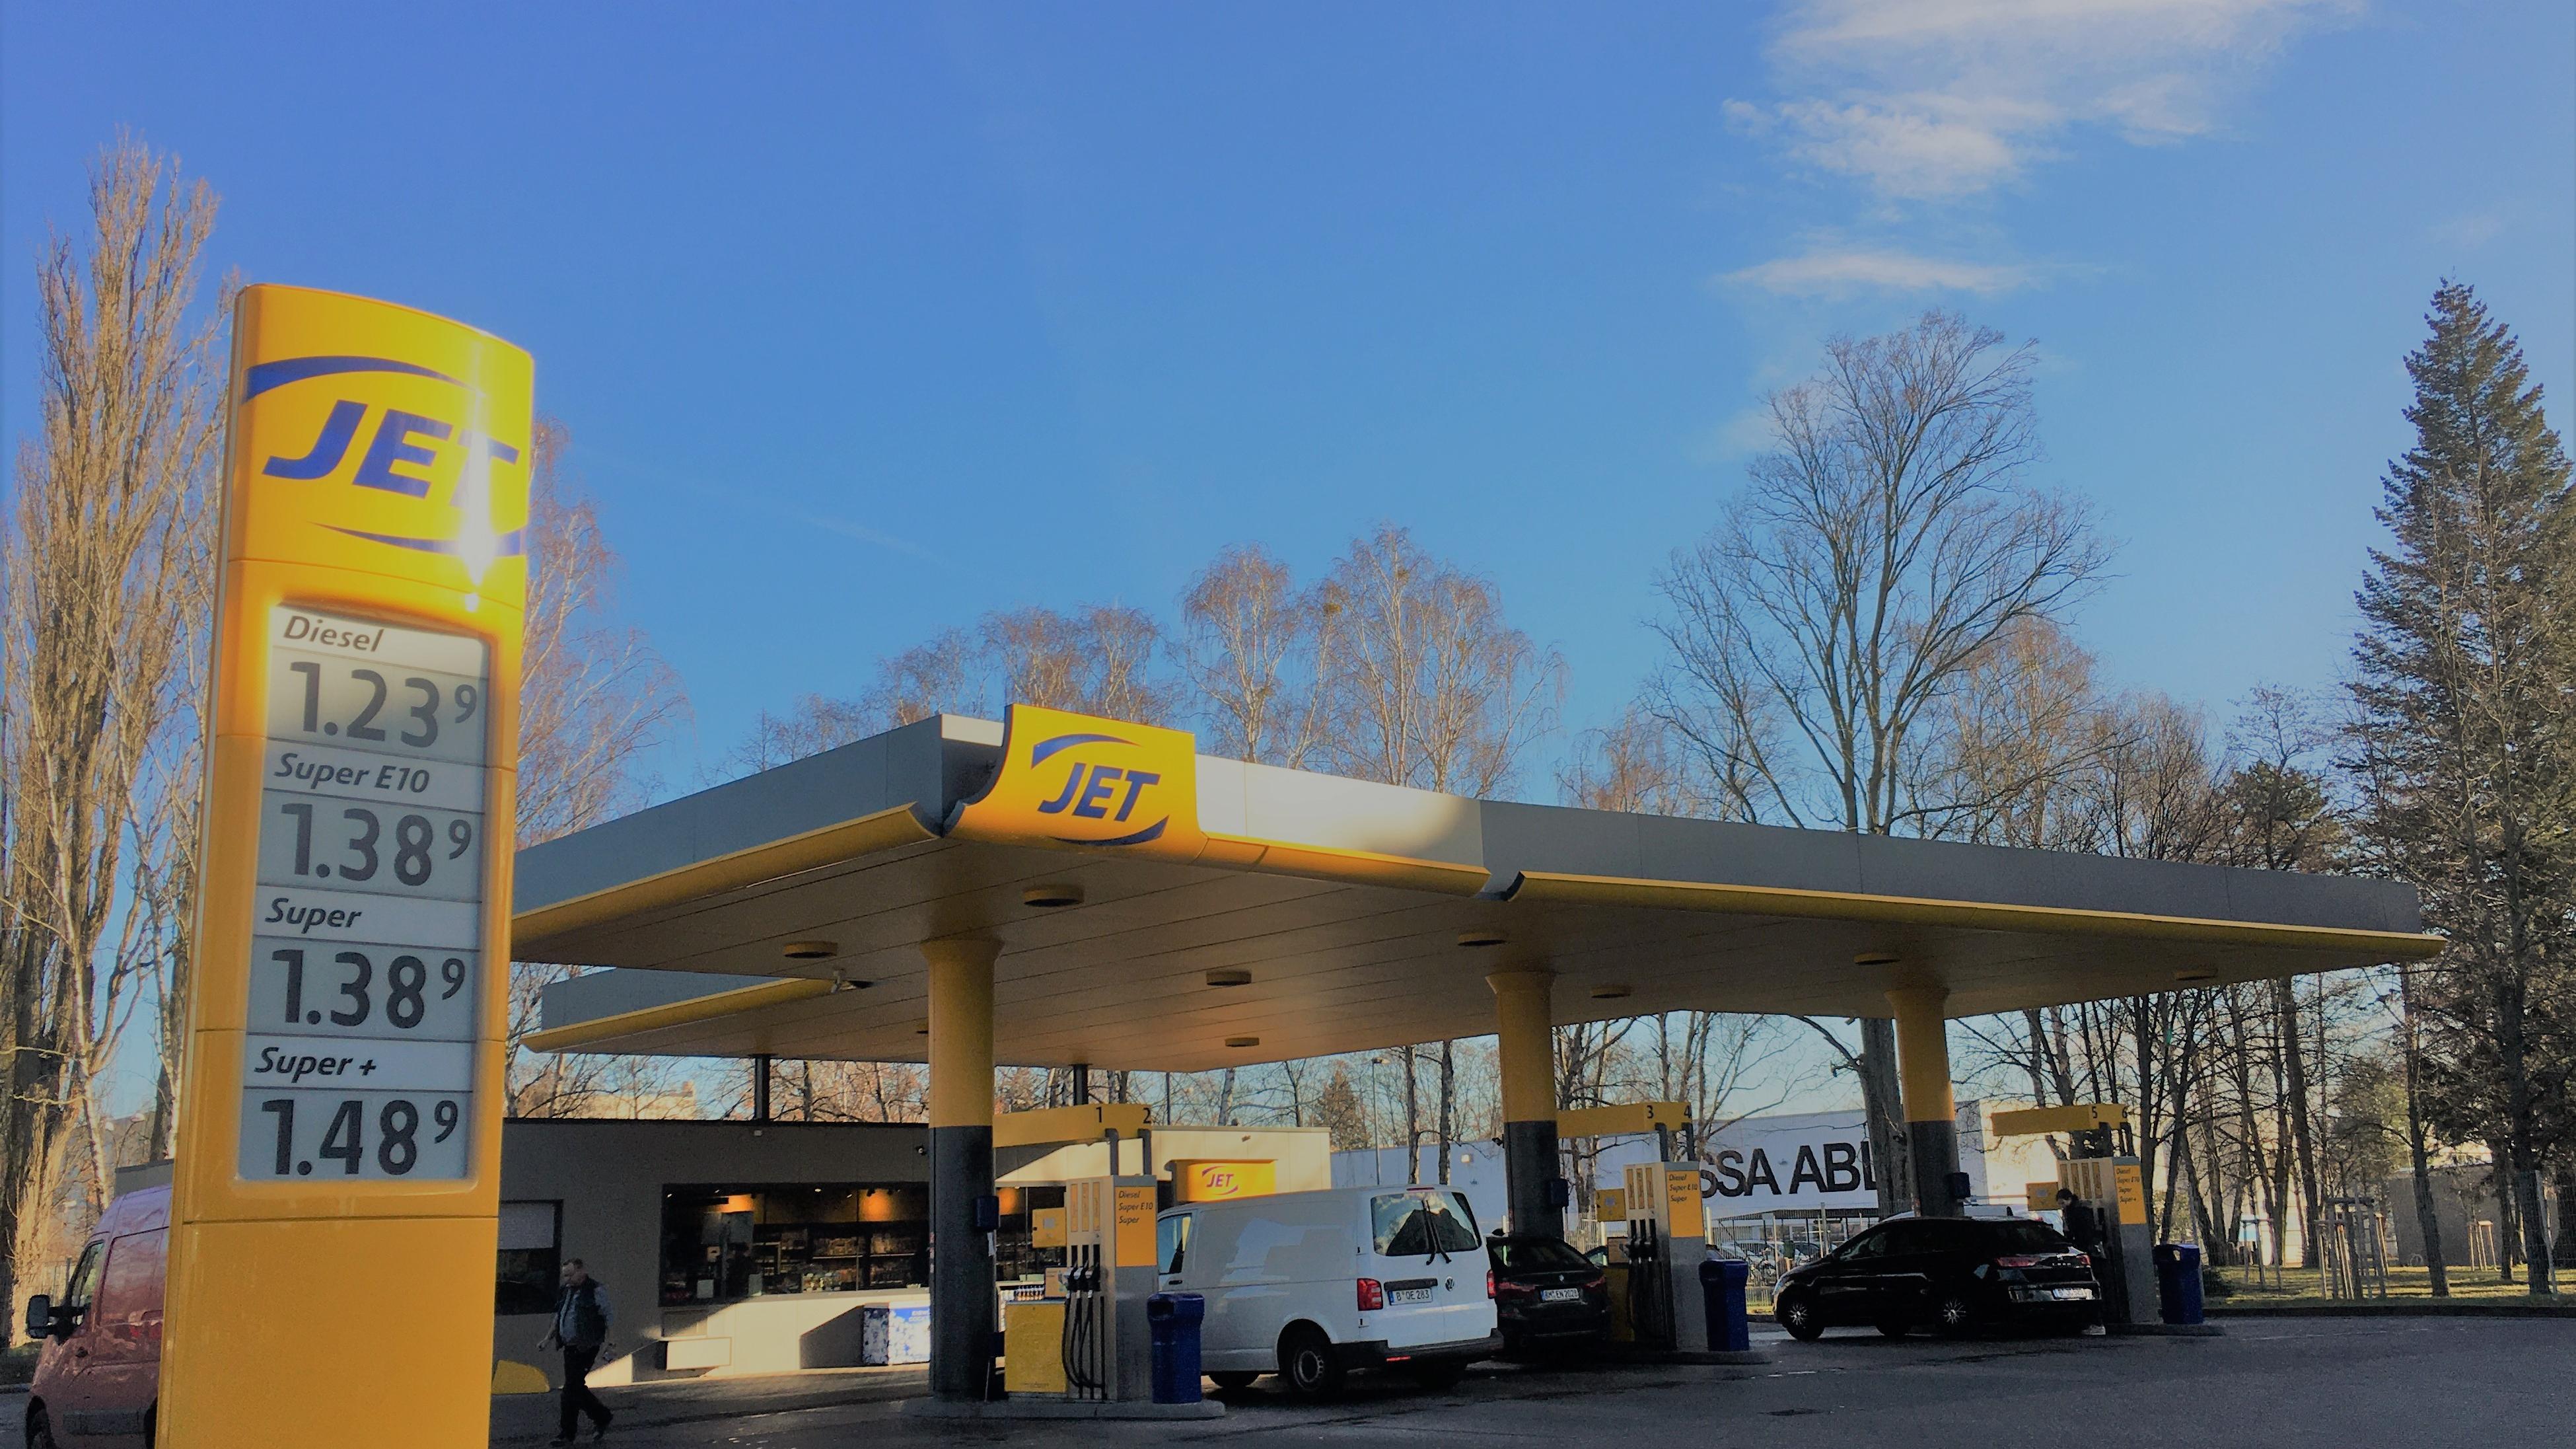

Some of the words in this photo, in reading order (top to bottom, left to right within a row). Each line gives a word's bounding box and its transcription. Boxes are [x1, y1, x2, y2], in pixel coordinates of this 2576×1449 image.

[262, 399, 520, 510] JET
[283, 615, 384, 652] Diesel
[274, 753, 369, 790] Super
[375, 764, 430, 793] E10
[1037, 762, 1161, 822] JET
[265, 897, 361, 934] Super
[1096, 1106, 1102, 1123] 1
[1143, 1107, 1151, 1124] 2
[1647, 1105, 1654, 1119] 3
[1684, 1105, 1692, 1119] 4
[2092, 1106, 2098, 1119] 5
[2122, 1106, 2128, 1119] 6
[1206, 1173, 1234, 1187] JET
[1118, 1190, 1141, 1199] Diesel
[1669, 1184, 1687, 1193] Super
[1670, 1195, 1687, 1204] Super
[1118, 1202, 1139, 1213] Super
[1118, 1216, 1140, 1226] Super
